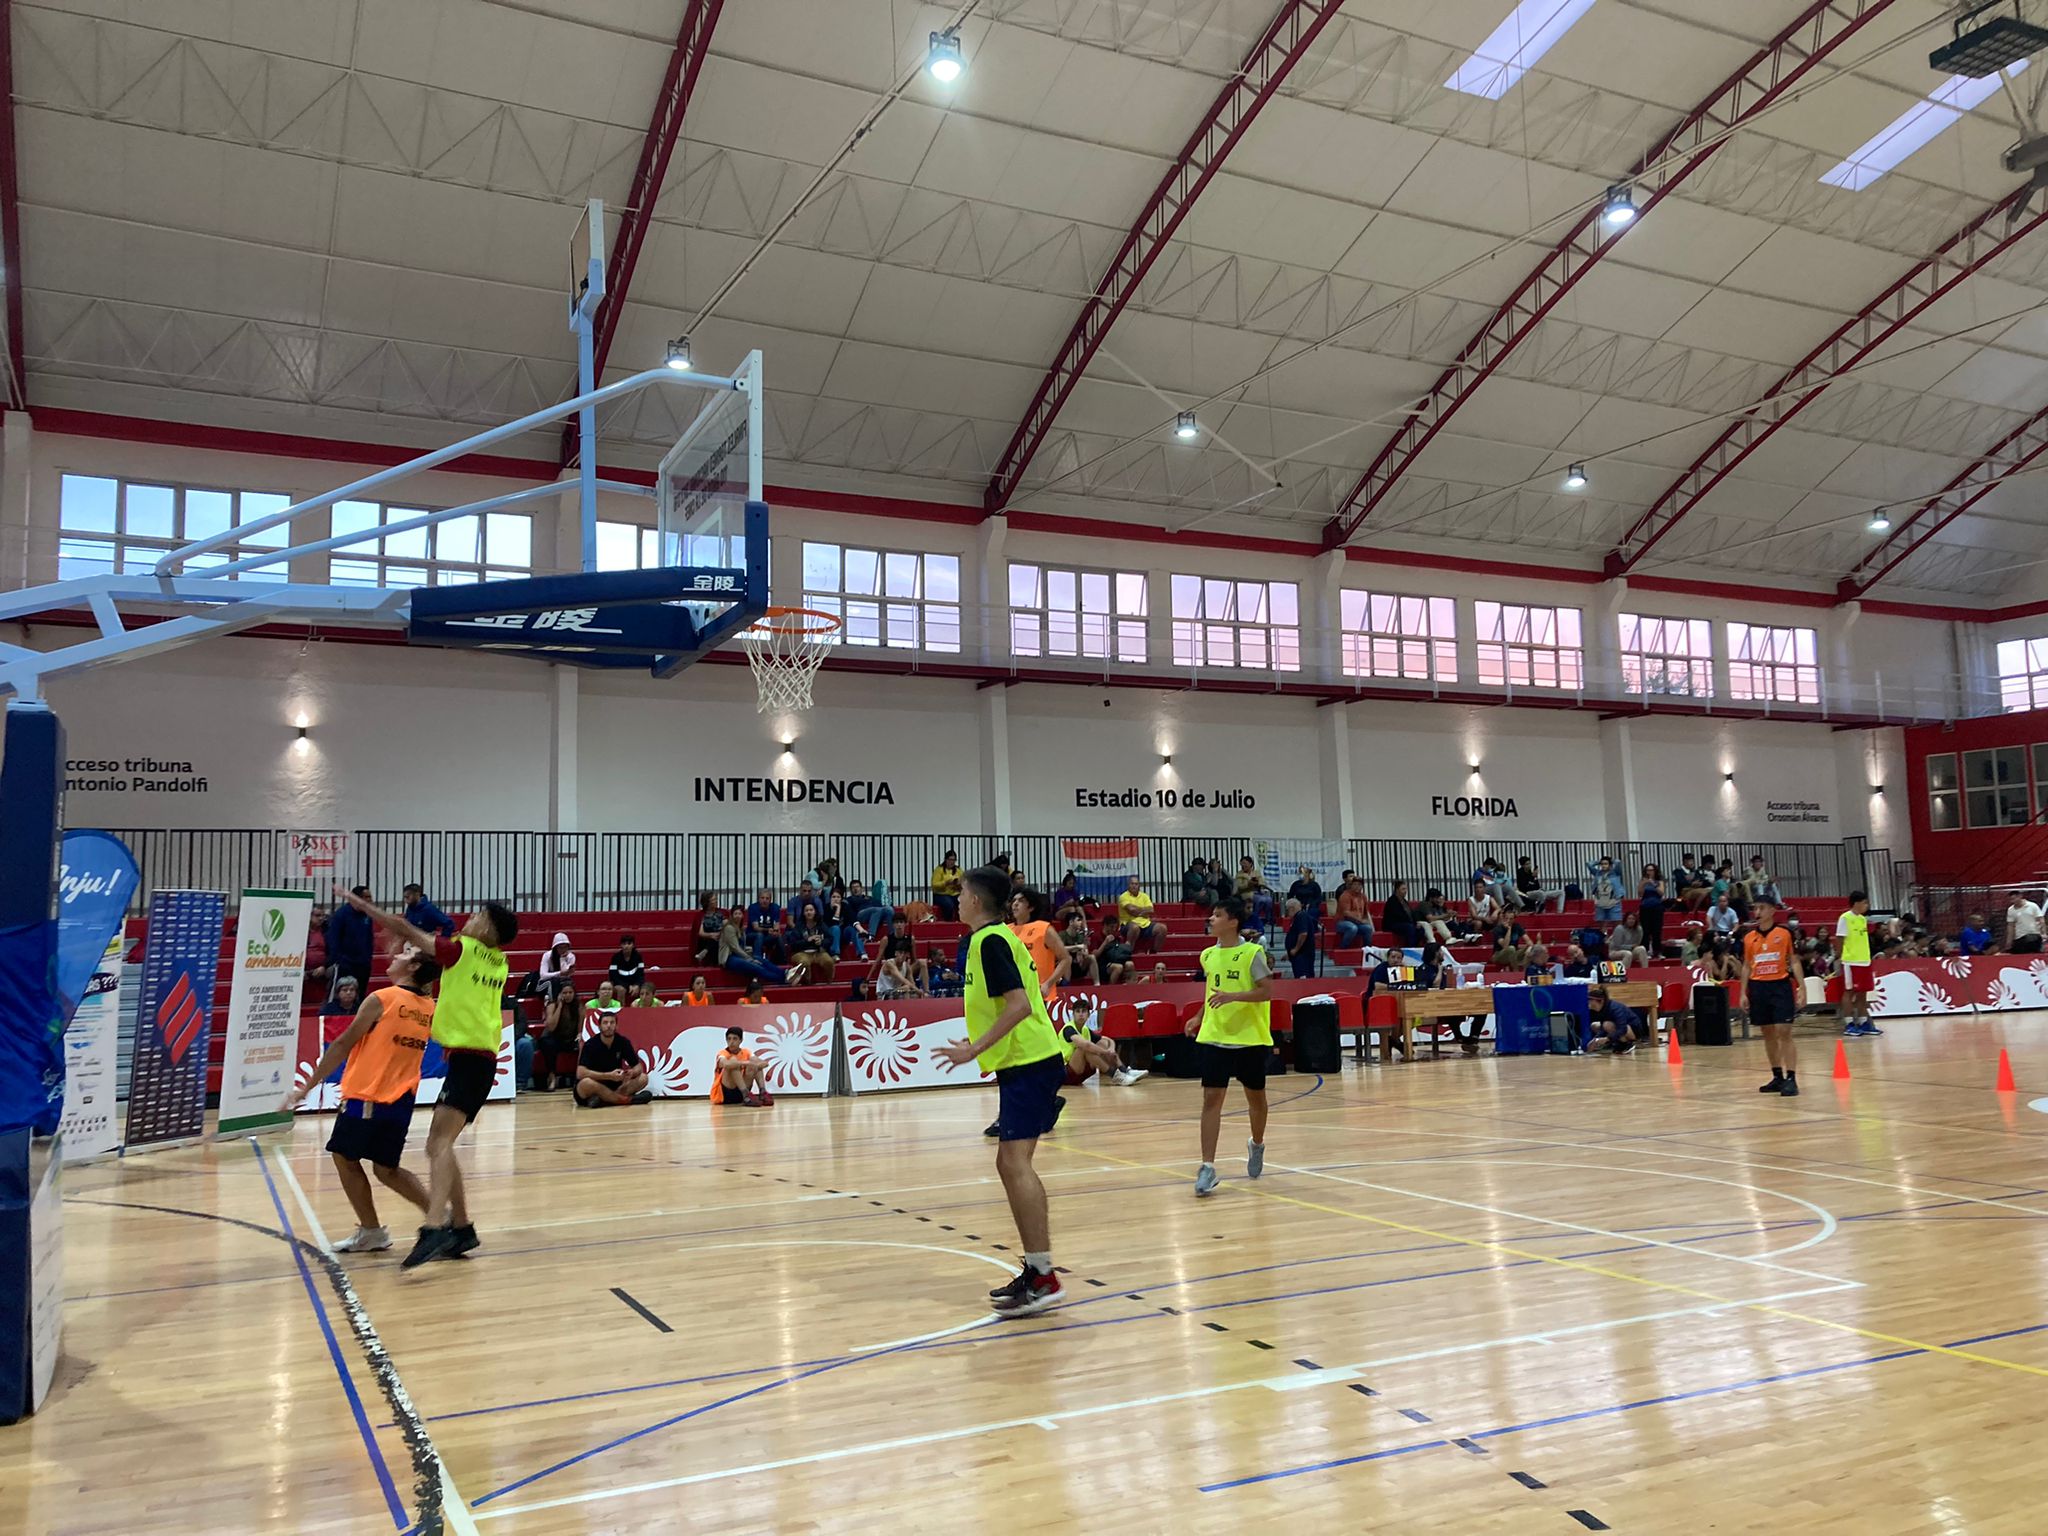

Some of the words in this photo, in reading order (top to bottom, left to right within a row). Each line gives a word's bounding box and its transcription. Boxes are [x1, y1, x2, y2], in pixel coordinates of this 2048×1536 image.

[693, 575, 735, 592] 金陵
[65, 759, 119, 772] cceso
[125, 758, 193, 773] tribuna
[65, 777, 127, 791] ntonio
[133, 777, 208, 792] Pandolfi
[694, 777, 895, 805] INTENDENCIA
[1075, 787, 1151, 808] Estadio
[1155, 789, 1177, 808] 10
[1182, 788, 1206, 808] de
[1209, 789, 1256, 809] Julio
[1431, 796, 1519, 818] FLORIDA
[247, 939, 270, 956] Eco
[245, 951, 305, 969] ambiental
[1617, 962, 1624, 974] 2
[1391, 968, 1398, 981] 1
